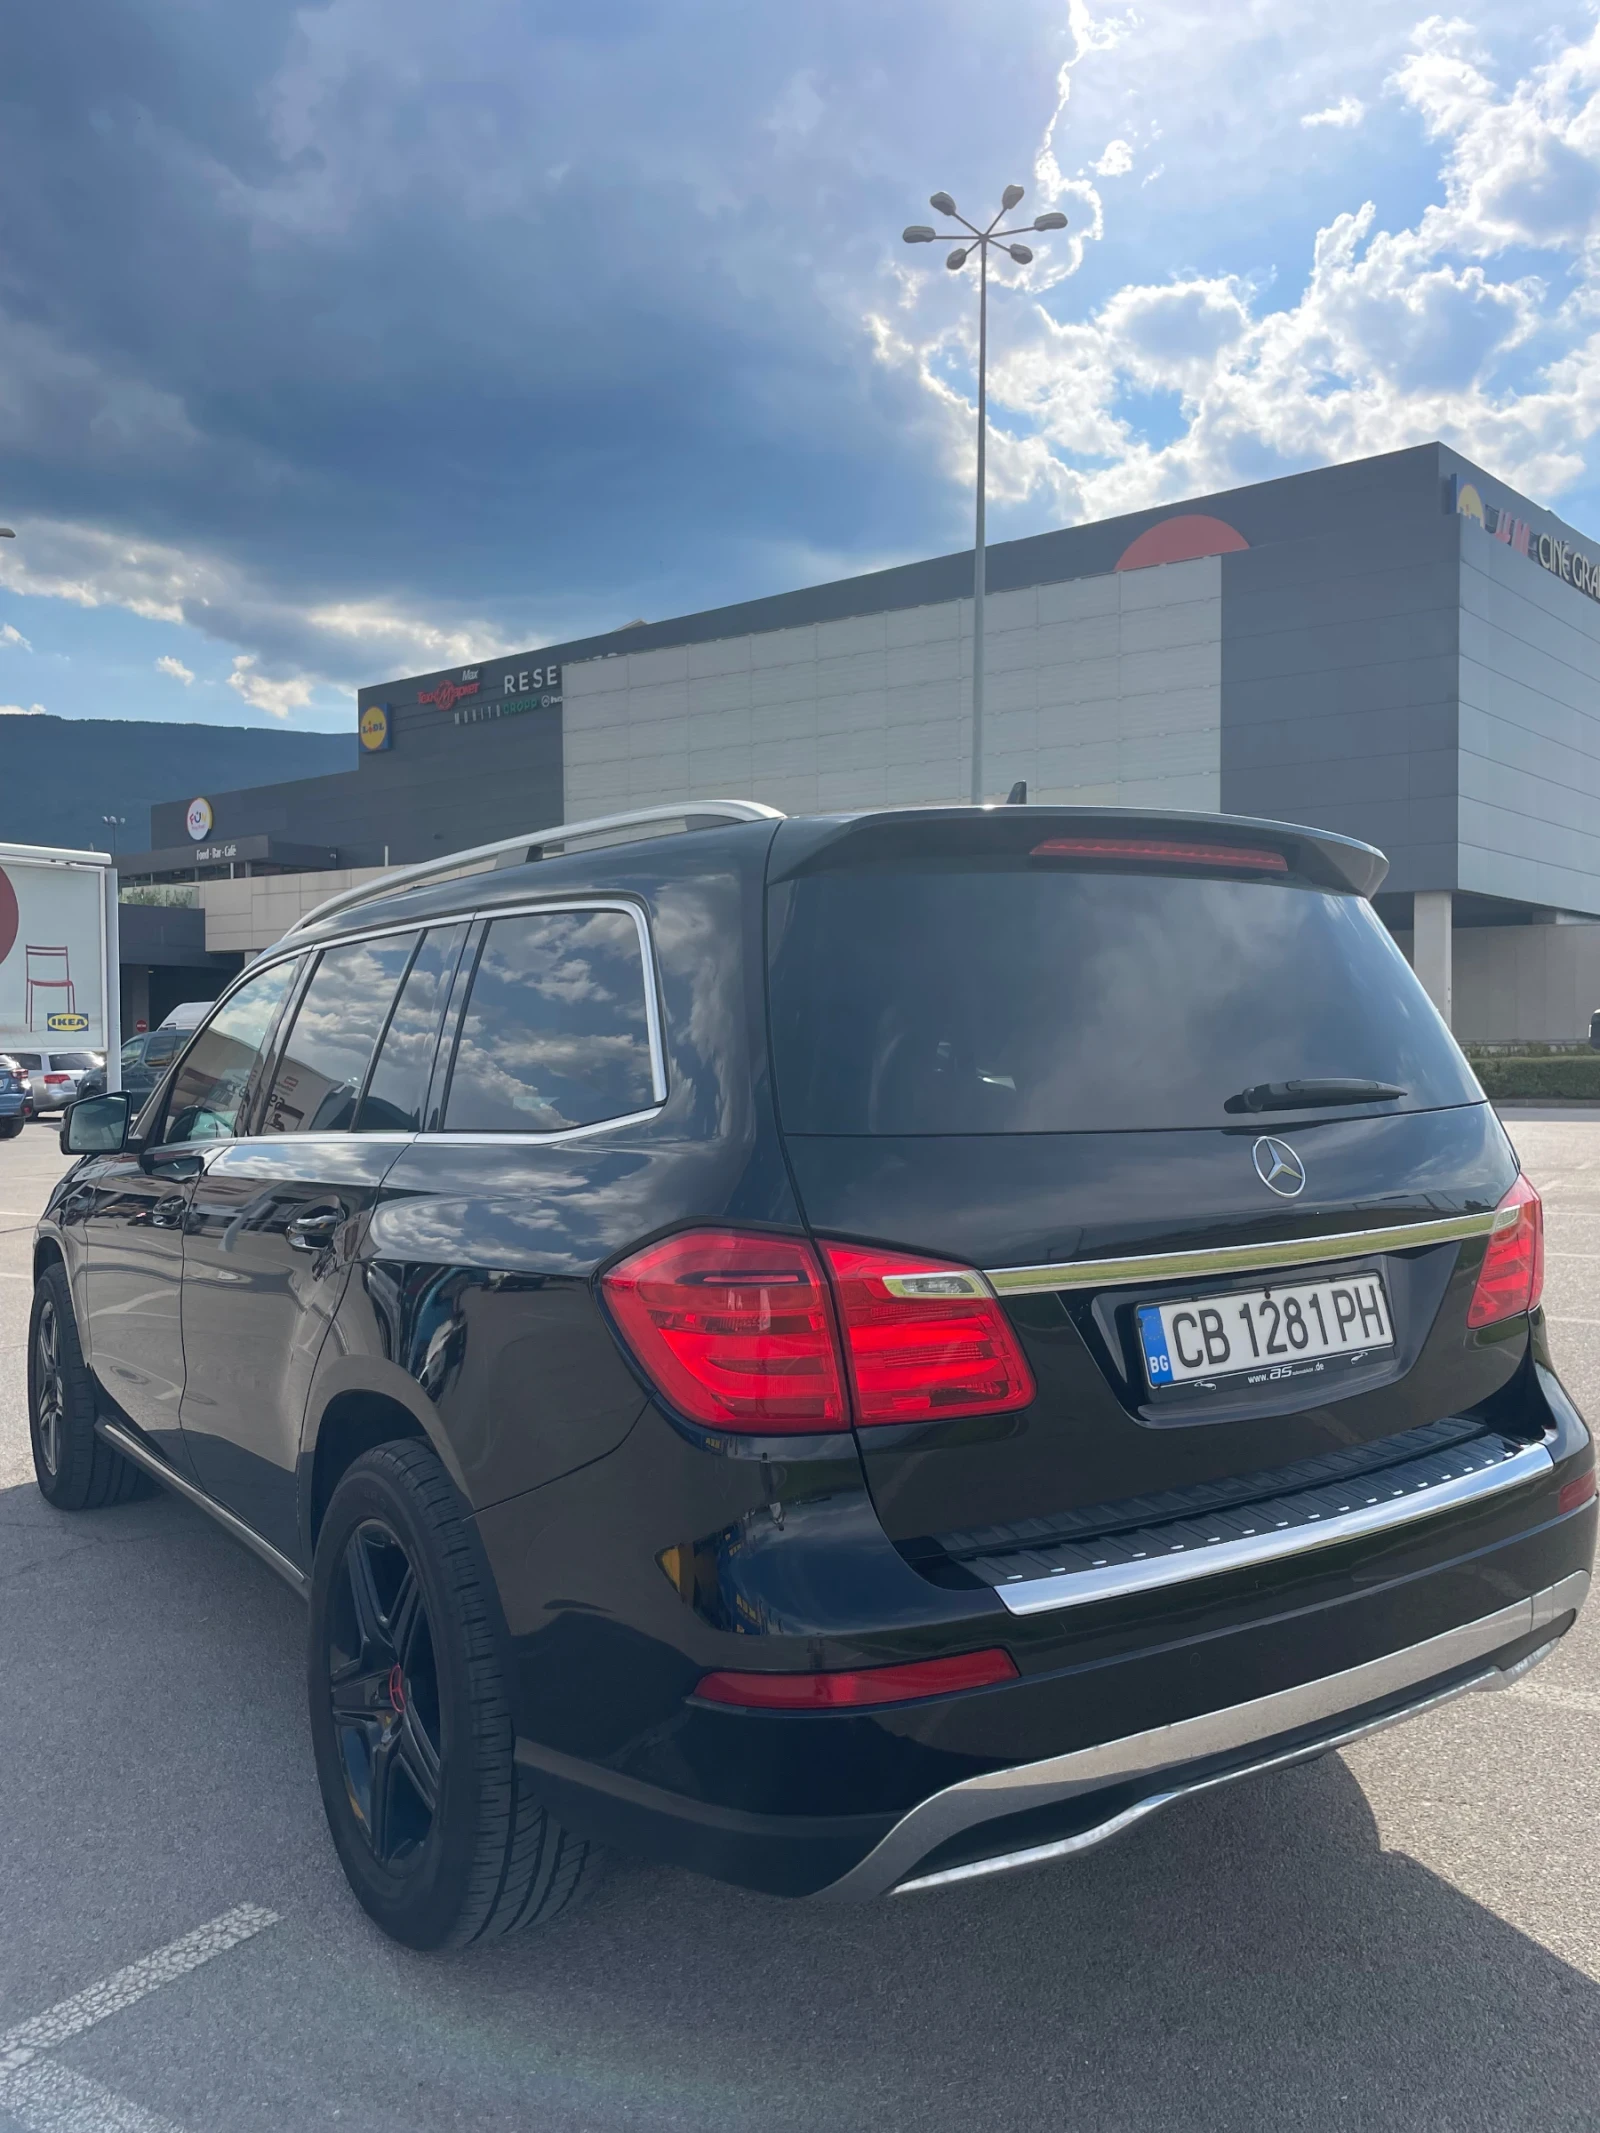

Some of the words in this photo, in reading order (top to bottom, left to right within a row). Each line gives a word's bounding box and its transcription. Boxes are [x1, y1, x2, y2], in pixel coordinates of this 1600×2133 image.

[1572, 552, 1600, 600] GRA
[461, 669, 479, 681] Max
[504, 665, 558, 694] RESE
[51, 1018, 86, 1026] IKEA
[1172, 1308, 1231, 1368] CB
[1239, 1292, 1329, 1358] 1281
[1331, 1284, 1385, 1343] PH
[1150, 1354, 1169, 1374] BG
